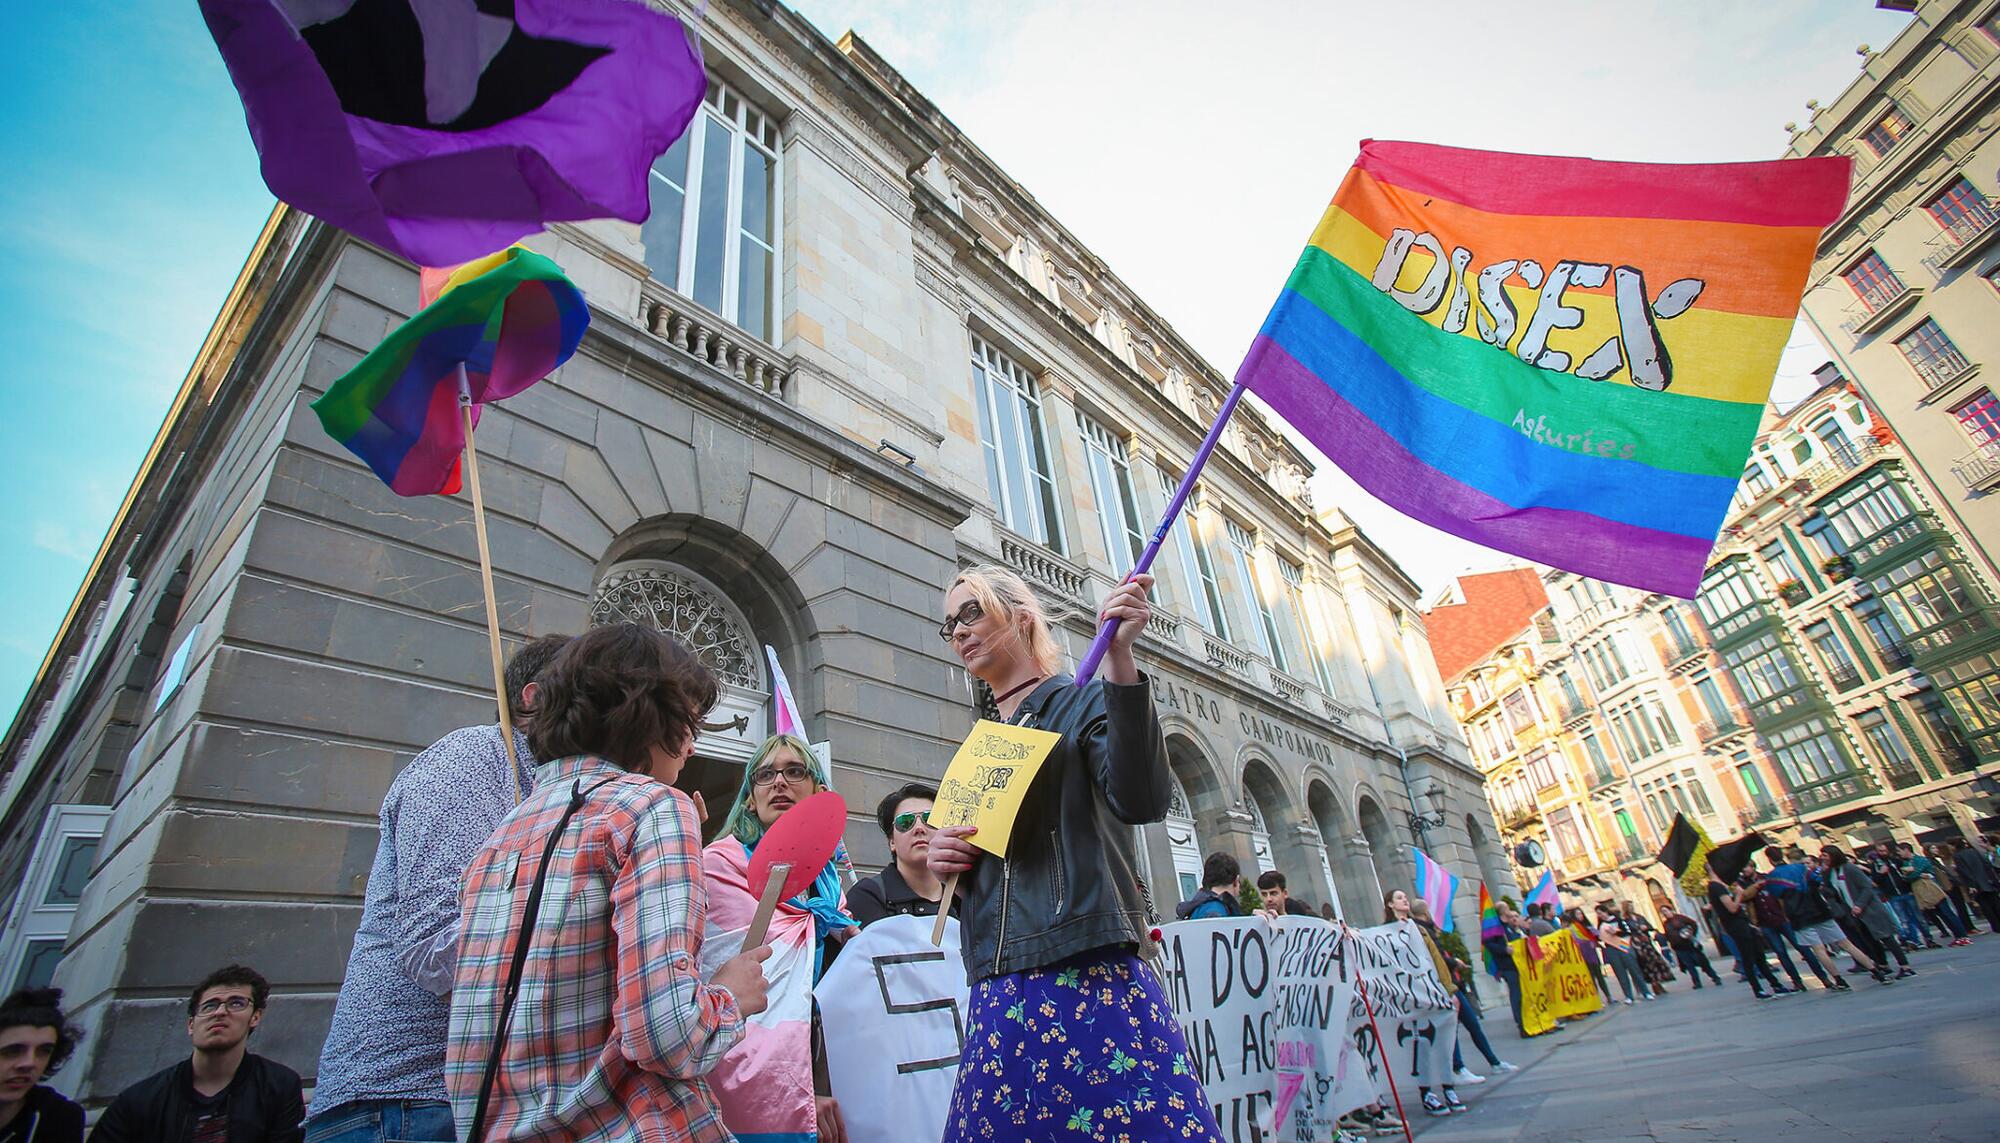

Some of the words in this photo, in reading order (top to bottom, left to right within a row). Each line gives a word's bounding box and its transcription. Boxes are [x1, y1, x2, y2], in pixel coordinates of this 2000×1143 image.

[1511, 408, 1637, 461] Asturies
[1150, 674, 1221, 725] EATRO
[1238, 711, 1335, 767] CAMPOAMOR
